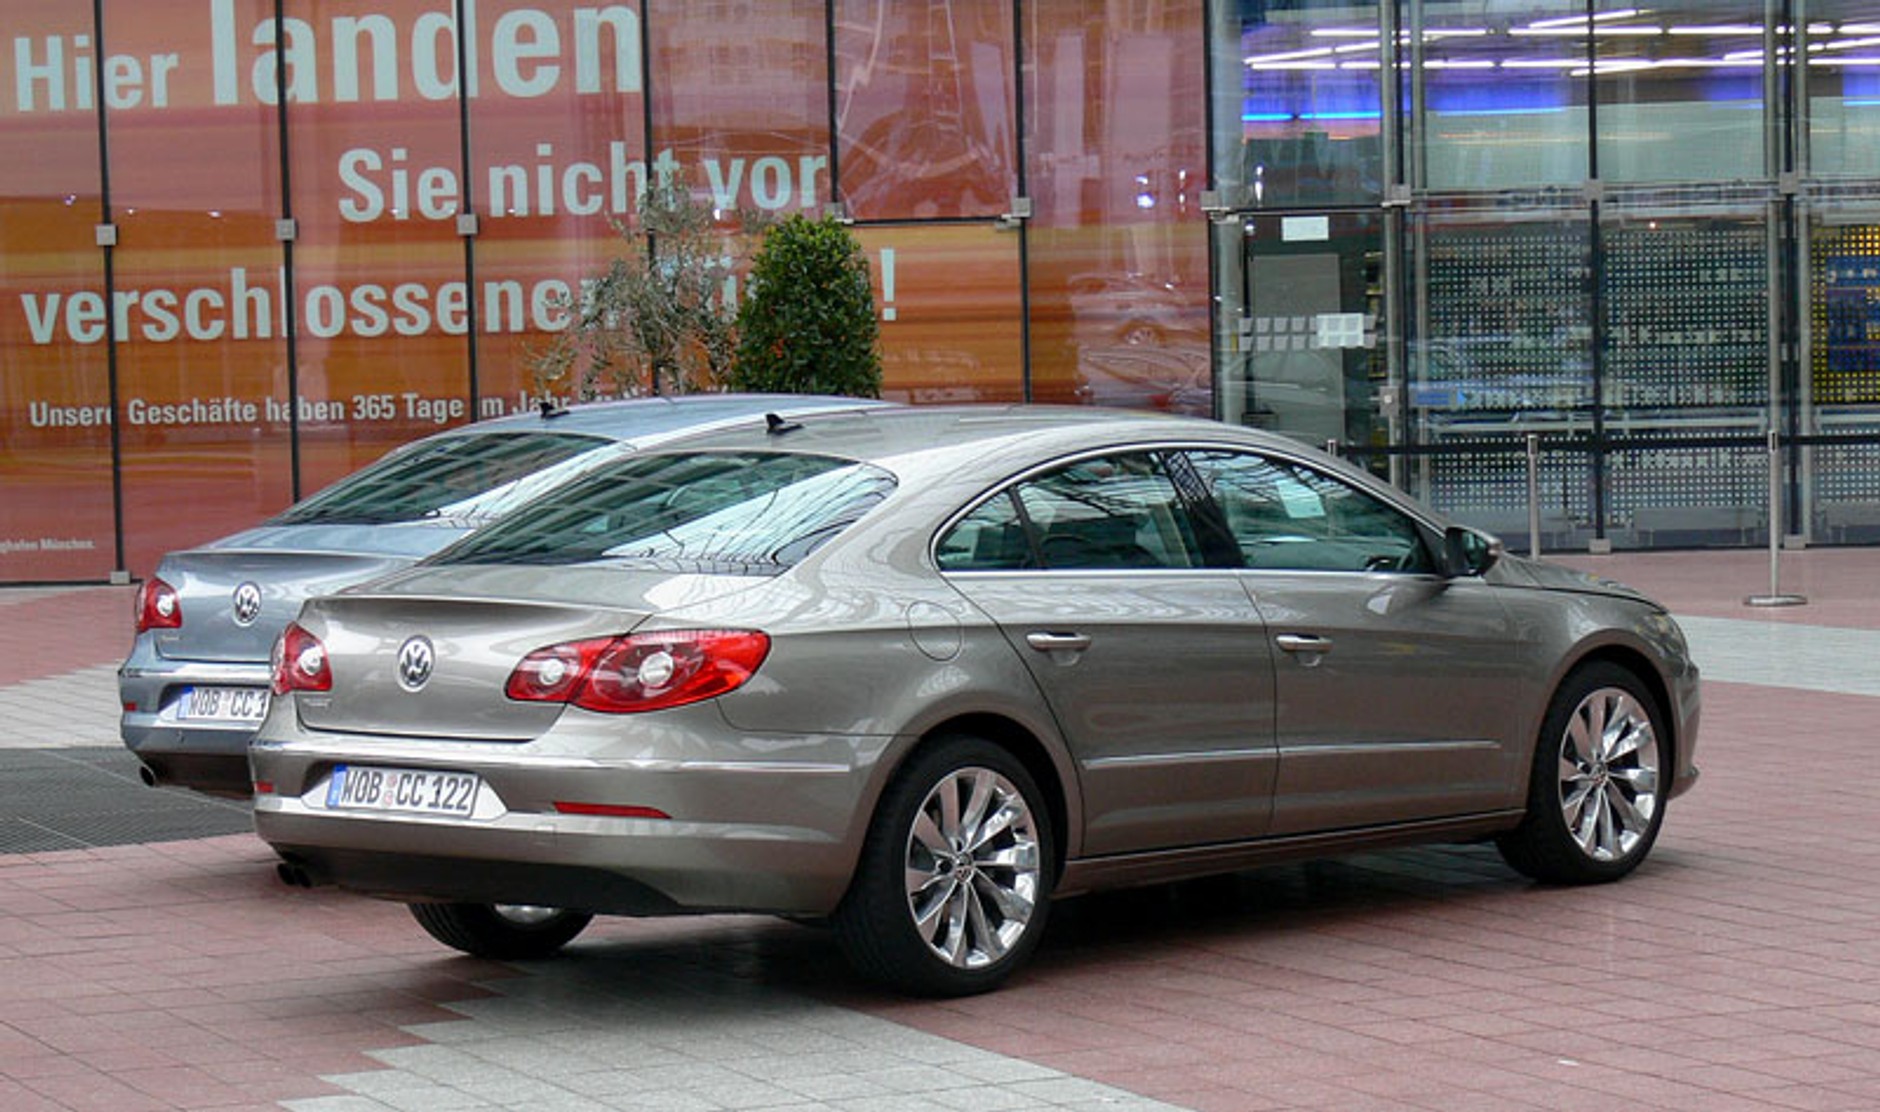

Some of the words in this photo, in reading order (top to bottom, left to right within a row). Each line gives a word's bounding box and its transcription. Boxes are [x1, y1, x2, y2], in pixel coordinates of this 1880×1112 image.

[14, 35, 178, 112] Hier
[211, 0, 643, 106] landen
[338, 148, 458, 223] Sie
[488, 140, 680, 218] nicht
[703, 154, 827, 211] vor
[127, 397, 257, 425] Geschäfte
[352, 394, 396, 420] 365
[402, 392, 464, 424] Tage
[188, 688, 221, 716] WOB
[231, 690, 255, 717] CC
[341, 768, 383, 804] WOB
[396, 773, 426, 808] CC
[427, 775, 474, 811] 122
